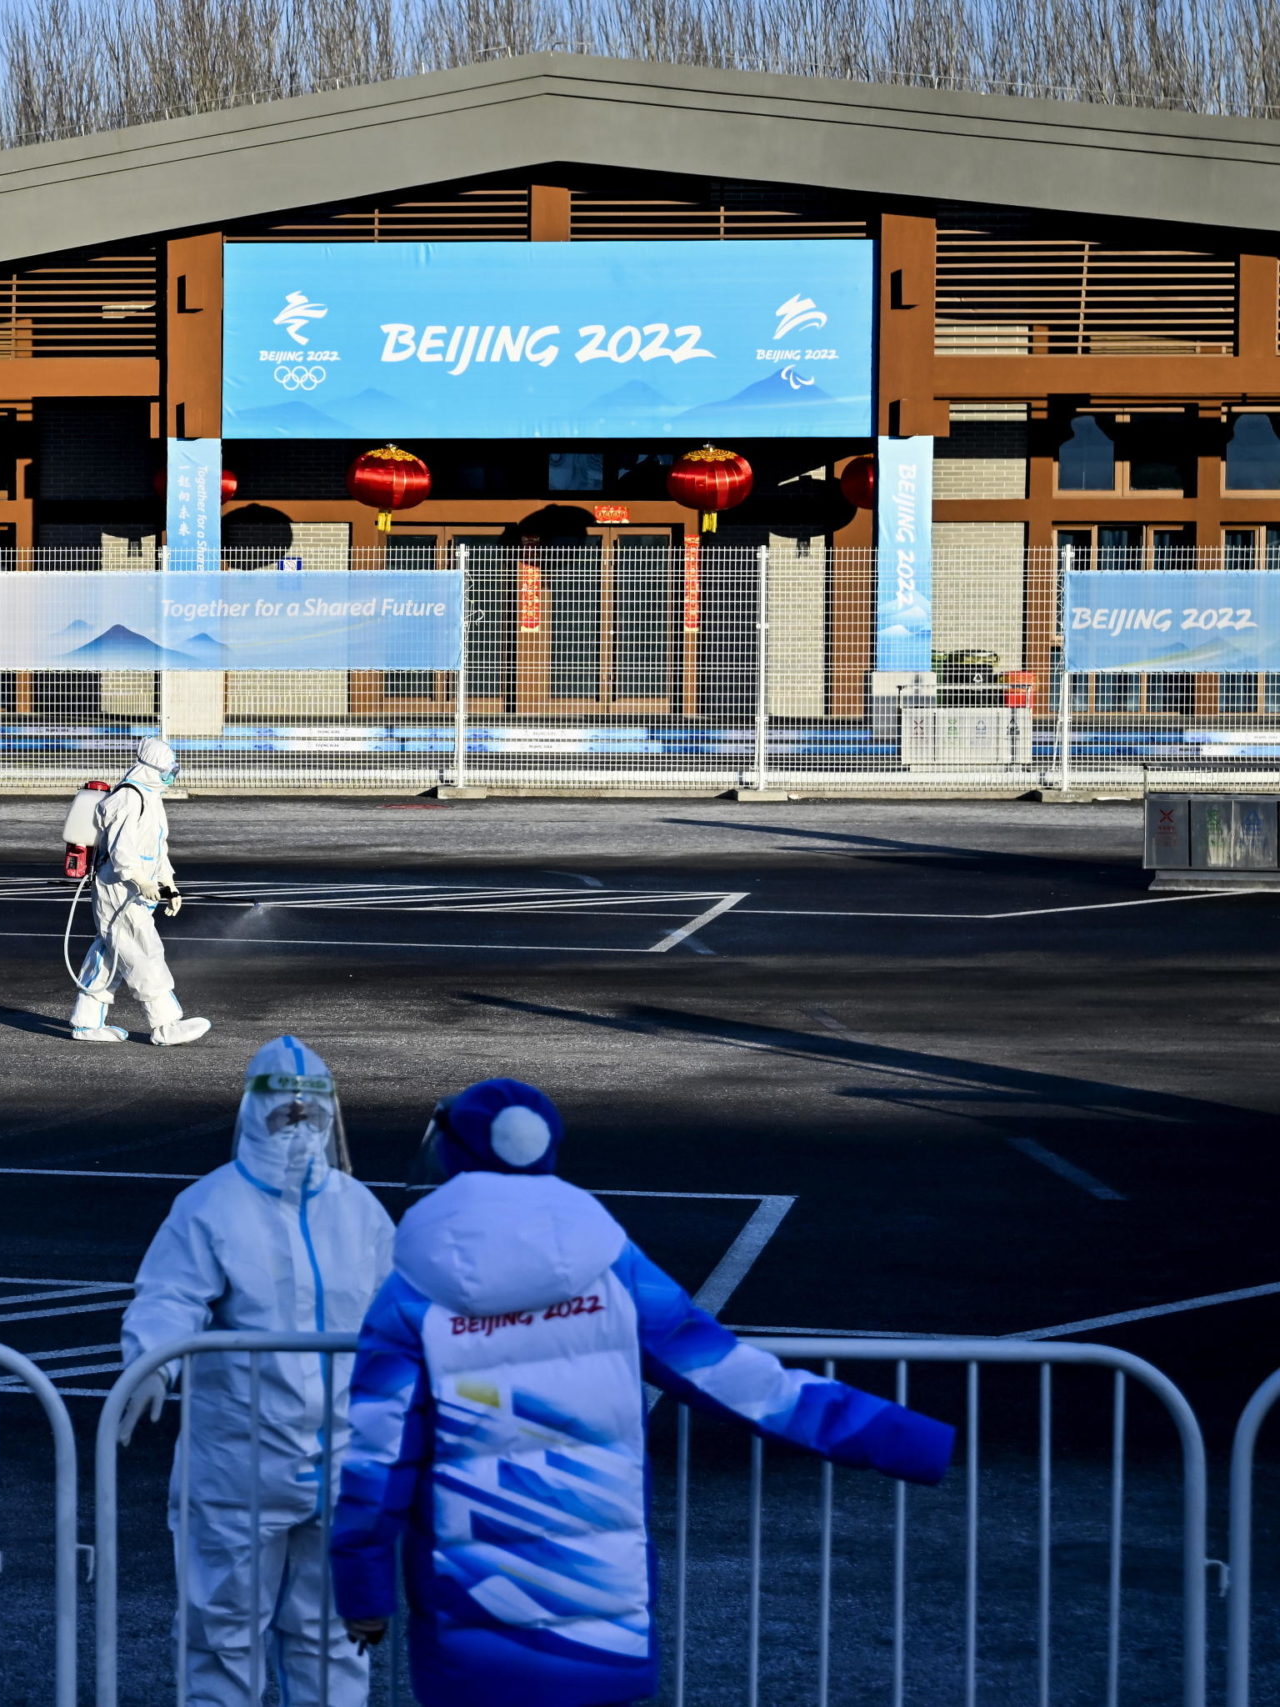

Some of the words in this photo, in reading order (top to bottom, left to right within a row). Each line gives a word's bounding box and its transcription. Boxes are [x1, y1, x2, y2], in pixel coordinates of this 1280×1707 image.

[259, 350, 305, 364] BEIJING
[306, 350, 342, 361] 2022
[380, 323, 561, 376] BEIJING
[574, 322, 718, 364] 2022
[755, 349, 801, 363] BEIJING
[804, 349, 839, 360] 2022
[195, 465, 208, 512] Together
[892, 464, 917, 543] BEIJING
[196, 514, 208, 529] for
[196, 530, 205, 538] a
[895, 549, 916, 610] 2022
[161, 599, 248, 621] Together
[255, 599, 282, 617] for
[287, 603, 300, 617] a
[303, 598, 377, 617] Shared
[381, 599, 447, 617] Future
[1071, 607, 1173, 637] BEIJING
[1180, 607, 1260, 631] 2022
[449, 1311, 535, 1336] BEIJING
[543, 1295, 606, 1320] 2022
